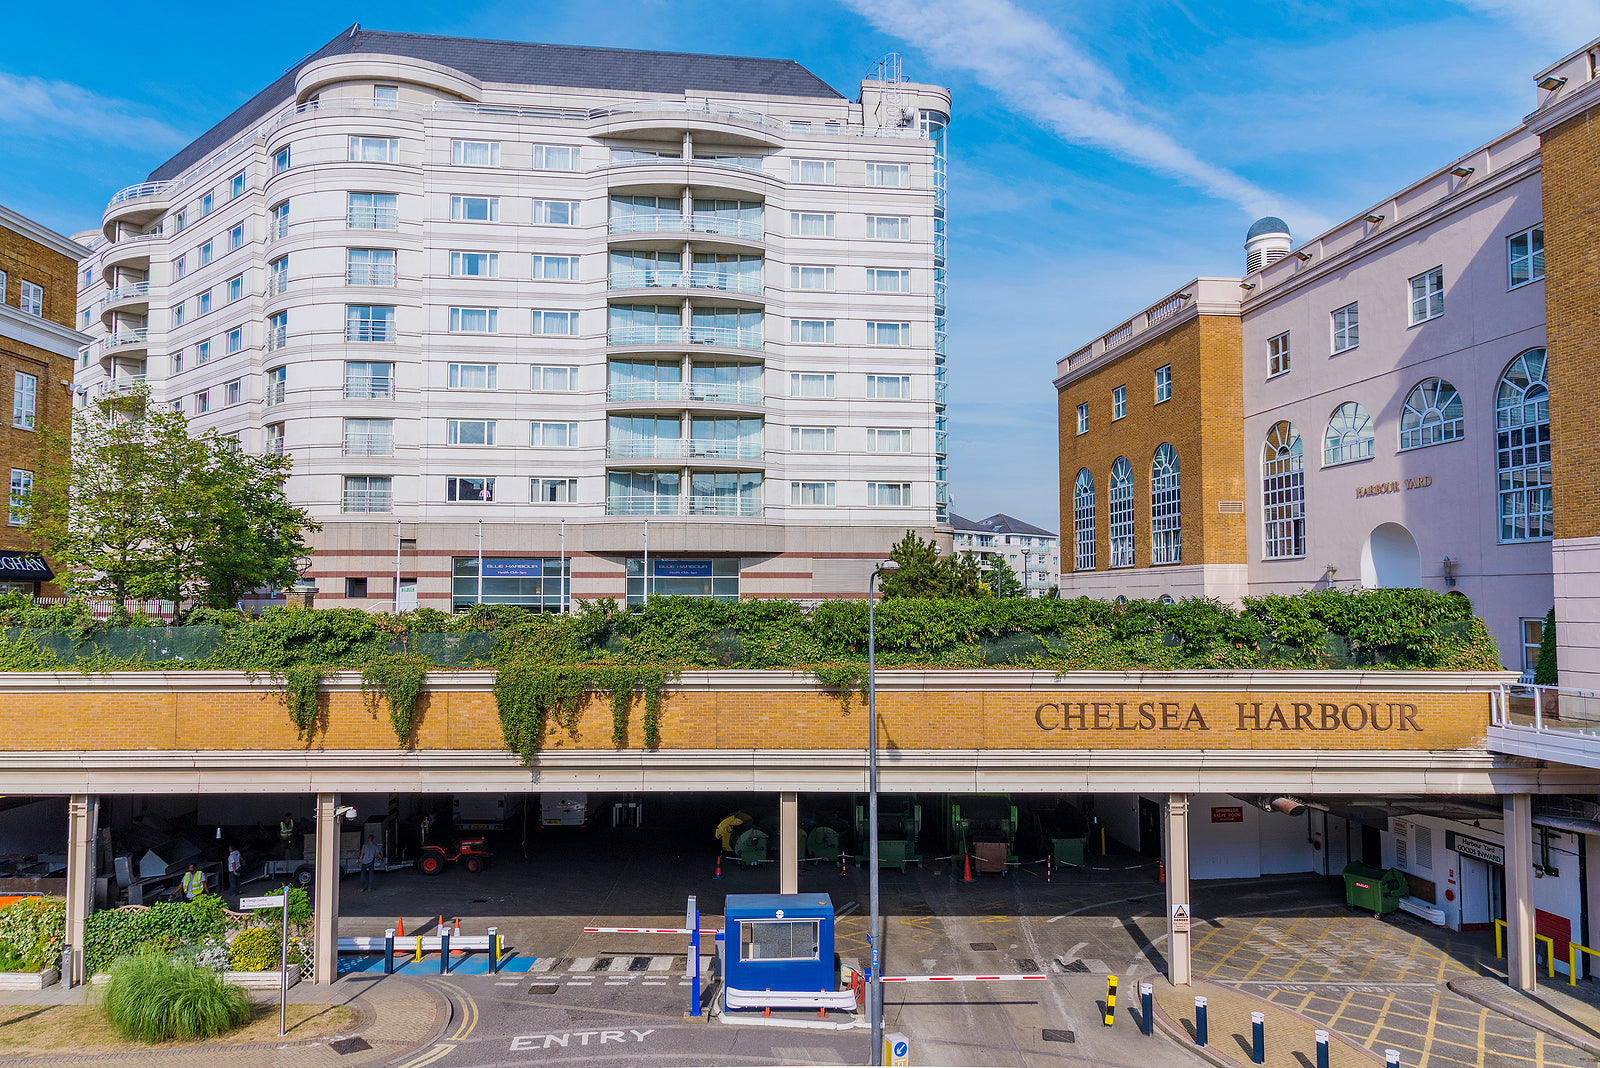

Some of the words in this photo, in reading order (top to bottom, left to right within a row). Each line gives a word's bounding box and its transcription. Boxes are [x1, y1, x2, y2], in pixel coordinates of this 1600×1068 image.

[1356, 481, 1400, 498] HARBOUR
[1405, 476, 1432, 489] YARD
[1034, 702, 1210, 732] CHELSEA
[1236, 702, 1423, 732] HARBOUR
[1457, 844, 1476, 855] GOODS
[1477, 851, 1501, 862] INWARD
[1462, 838, 1481, 849] Harbour
[1483, 844, 1496, 853] Yard
[509, 1029, 655, 1051] ENTRY
